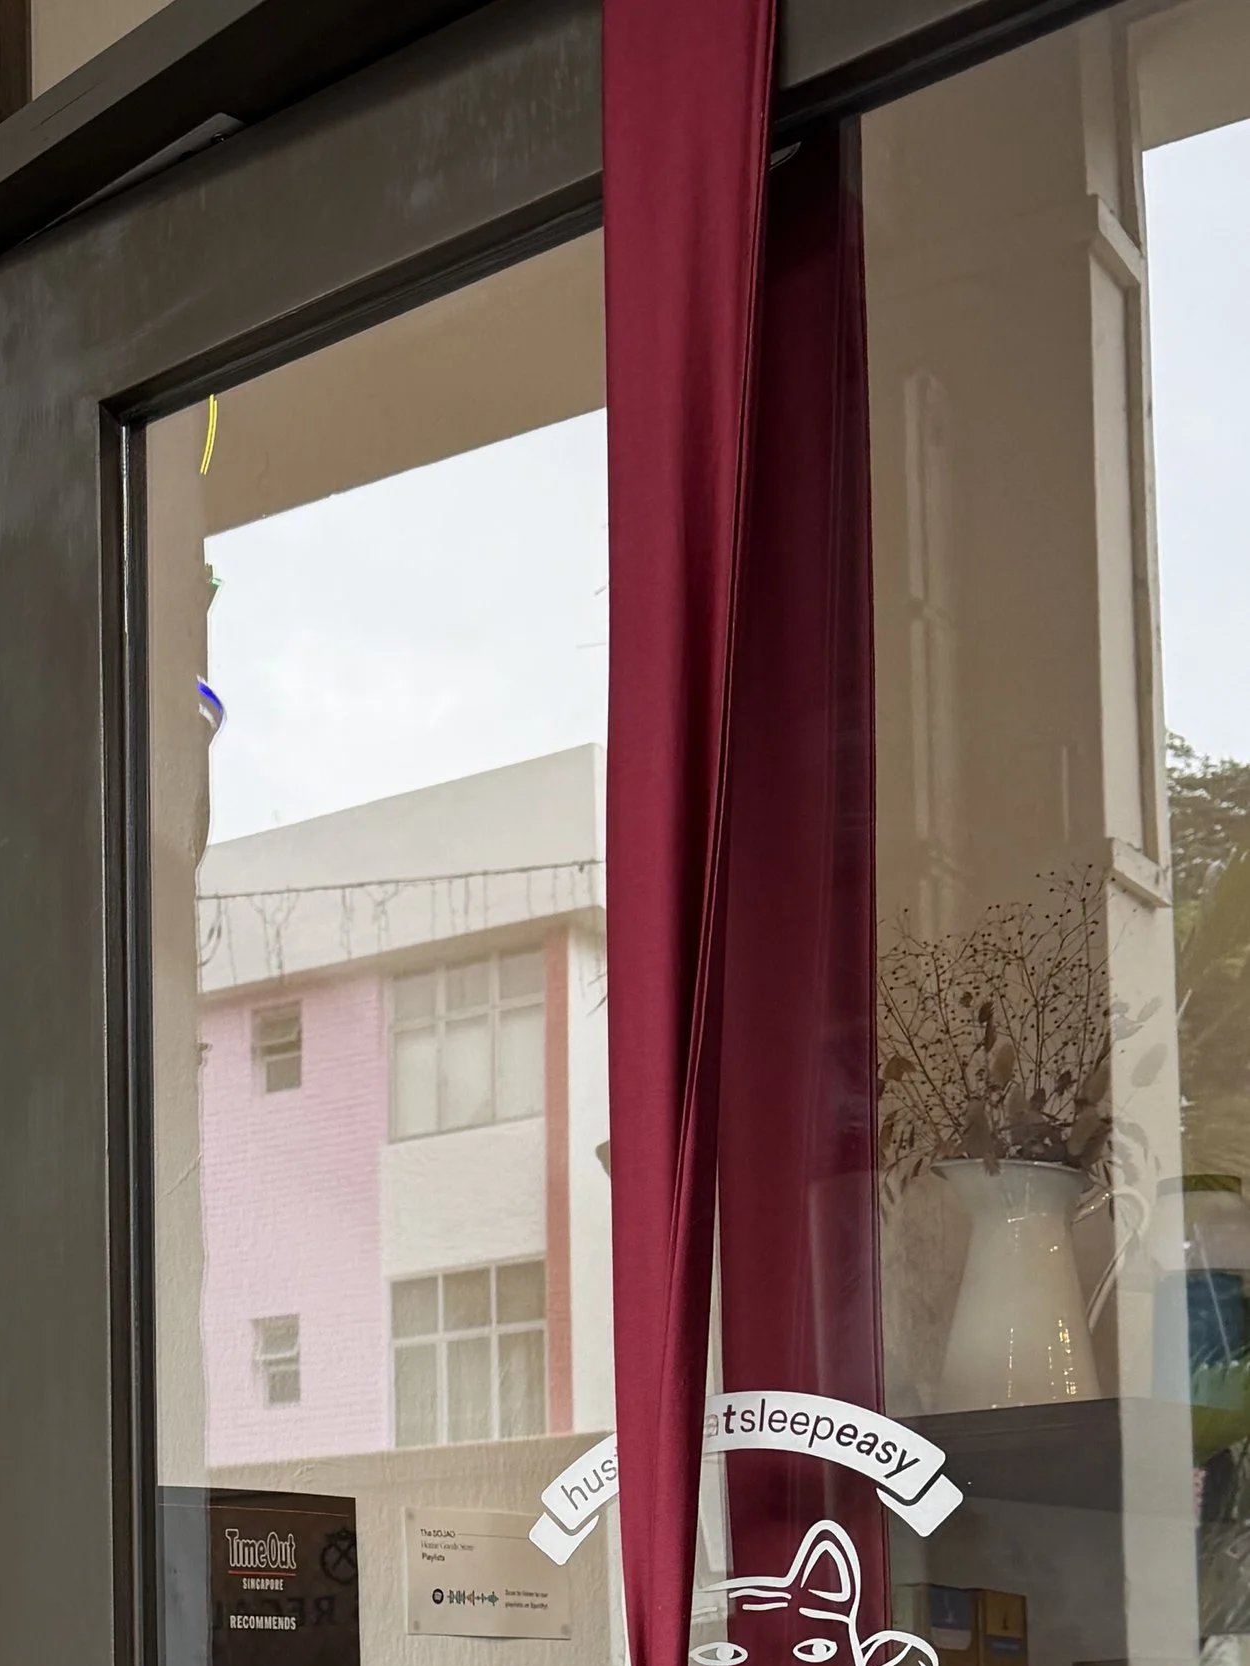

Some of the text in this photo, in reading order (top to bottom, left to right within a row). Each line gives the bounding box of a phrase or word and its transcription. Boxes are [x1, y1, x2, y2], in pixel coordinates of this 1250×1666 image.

[561, 1398, 920, 1511] hus atsleepeasy
[242, 1578, 284, 1591] SINGAPORE
[230, 1615, 297, 1630] RECOMMENDS
